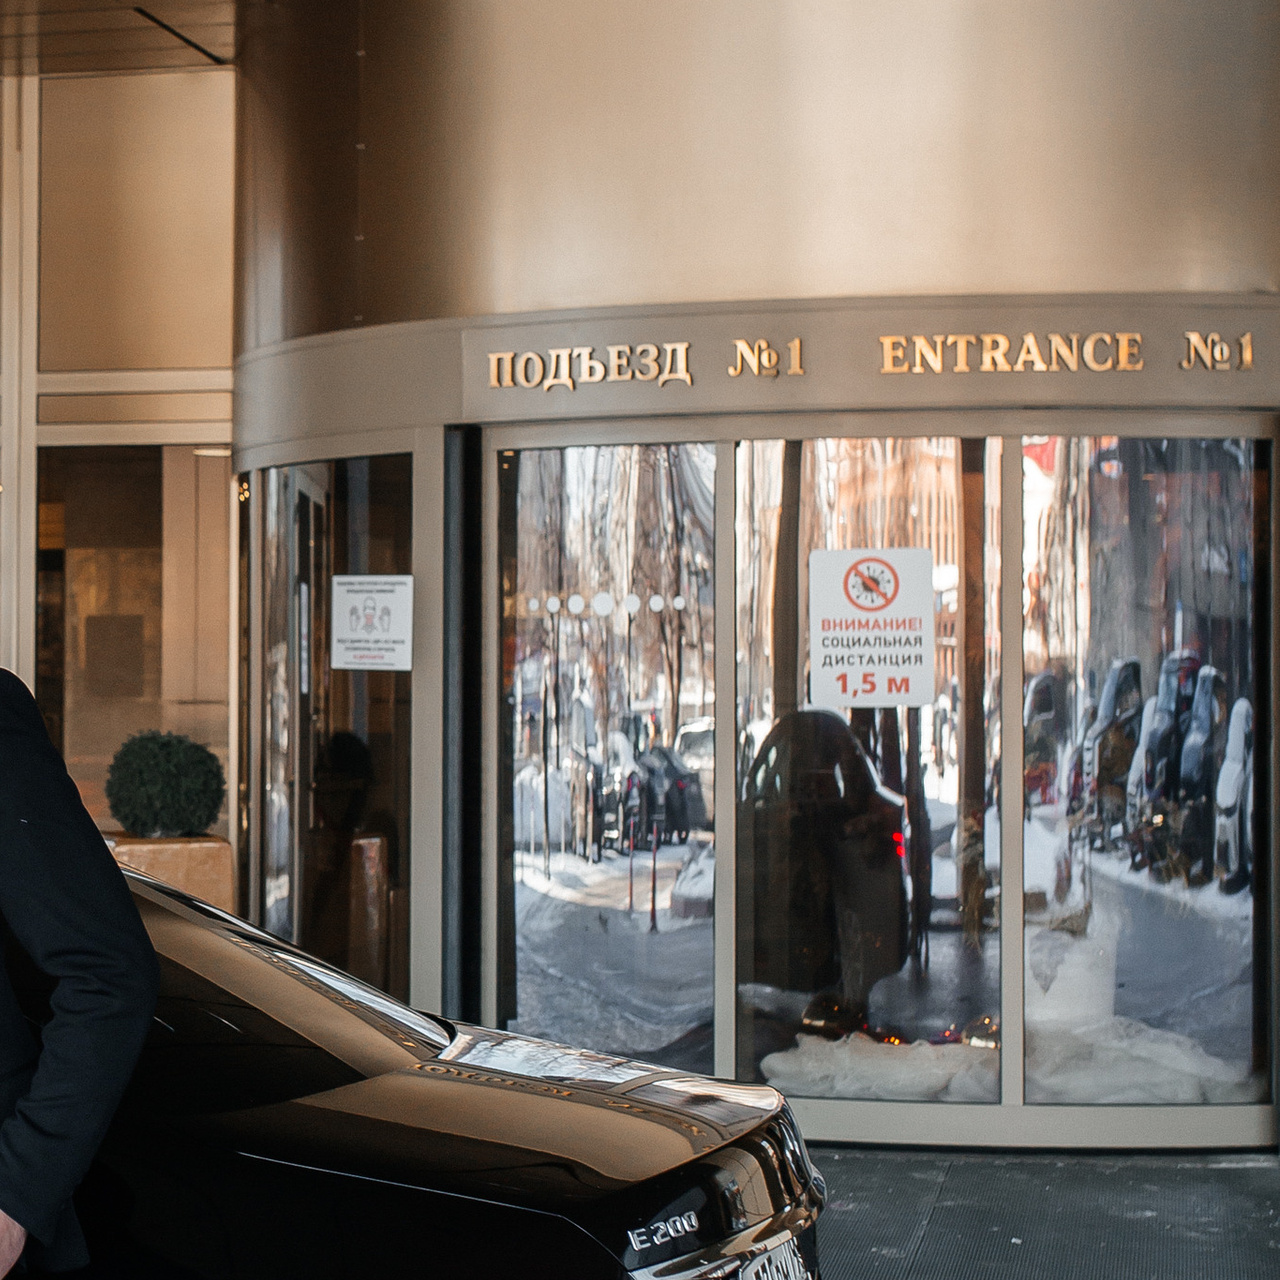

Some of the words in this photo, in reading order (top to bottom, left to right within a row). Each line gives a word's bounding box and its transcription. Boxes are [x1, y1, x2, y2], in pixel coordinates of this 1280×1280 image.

[879, 331, 1144, 375] ENTRANCE
[487, 341, 693, 392] ПОДЪЕЗД
[821, 618, 923, 632] ВНИМАНИЕ!
[821, 635, 923, 649] СОЦИАЛЬНАЯ
[821, 653, 923, 668] ДИСТАНЦИЯ
[835, 672, 877, 698] 1,5
